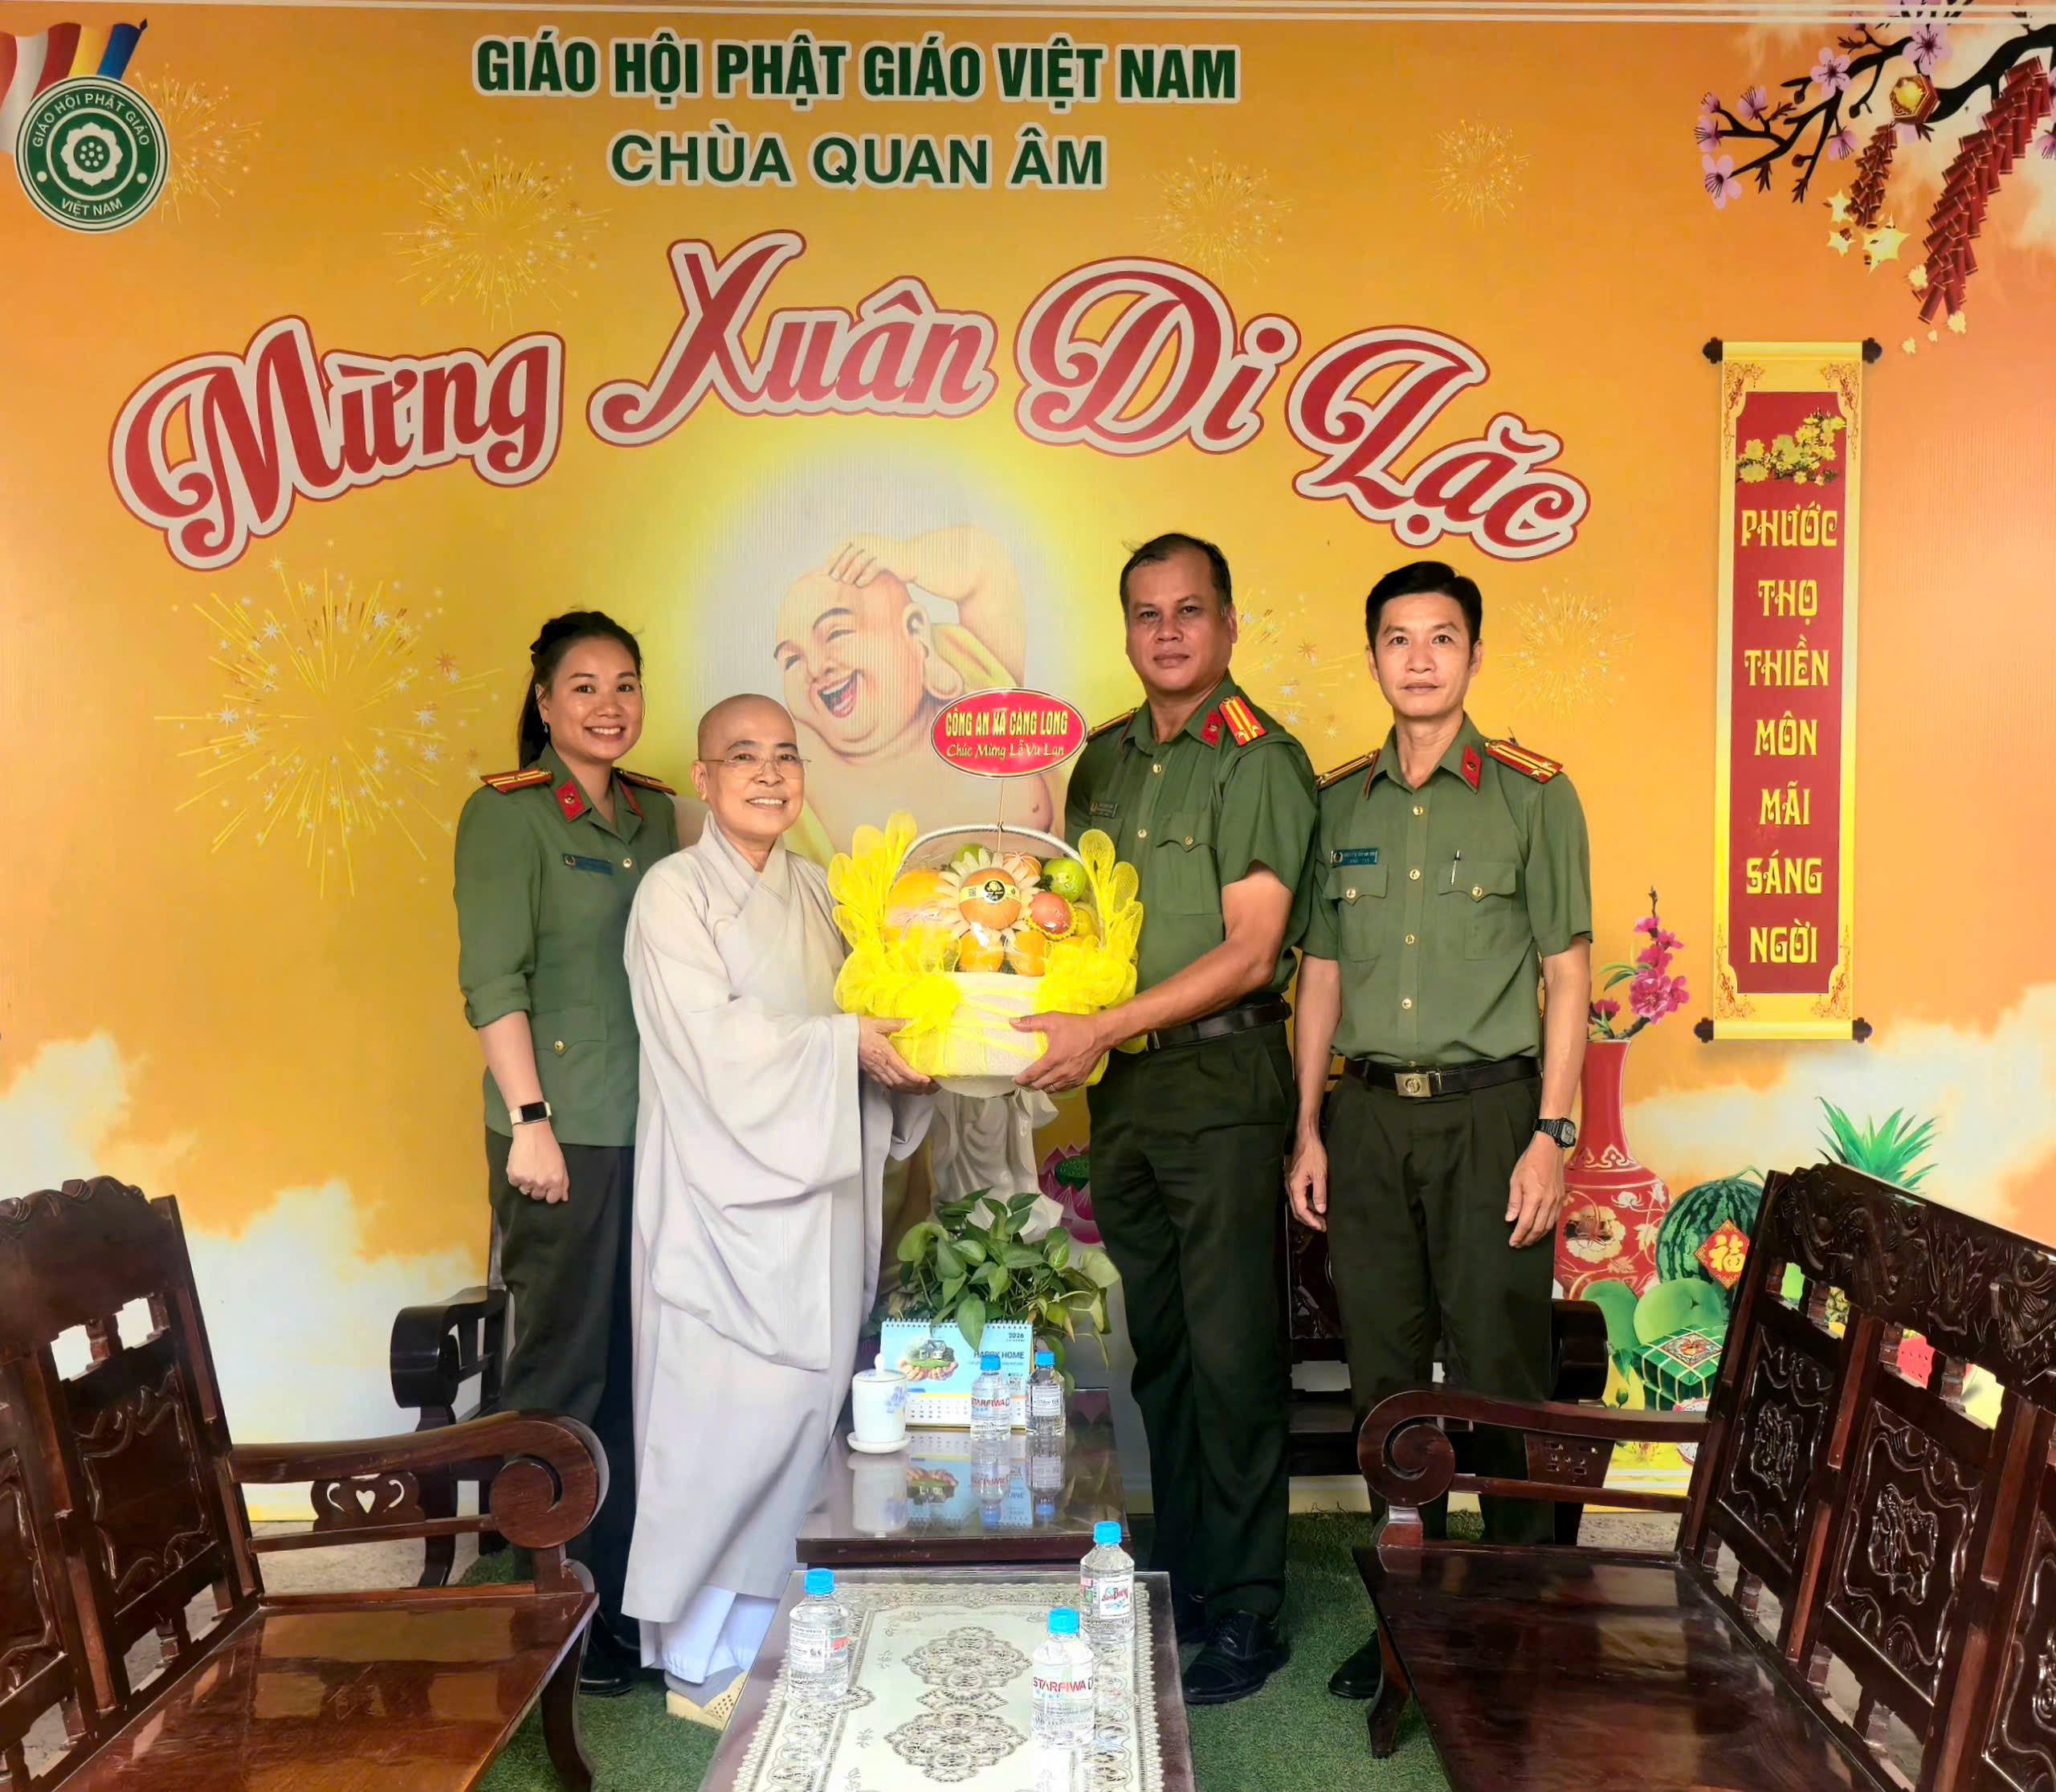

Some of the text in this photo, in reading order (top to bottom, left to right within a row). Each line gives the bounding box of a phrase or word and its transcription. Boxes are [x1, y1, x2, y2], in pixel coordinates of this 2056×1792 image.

[477, 31, 1236, 108] GIÁO HỘI PHẬT GIÁO VIỆT NAM
[33, 92, 150, 147] GIÁO HỘI PHẬT GIÁO
[611, 124, 1103, 185] CHÙA QUAN ÂM
[62, 198, 122, 216] VIỆT NAM
[123, 239, 1576, 557] Mừng Xuân Di Lặc
[1740, 500, 1838, 547] PHƯỚC
[1757, 579, 1818, 625] THỌ
[1744, 634, 1830, 687] THIỀN
[945, 708, 973, 737] CÔNG
[975, 712, 990, 737] AN
[1010, 707, 1037, 736] CÀNG
[1040, 710, 1068, 736] LONG
[1754, 710, 1817, 756] MÔN
[946, 739, 1065, 761] Chúc Mừng Lễ Vu Lan
[1759, 781, 1811, 826] MÃI
[1745, 848, 1822, 895] SÁNG
[1749, 918, 1818, 964] NGỜI
[1709, 1235, 1745, 1272] 福
[1001, 1351, 1026, 1359] HOME
